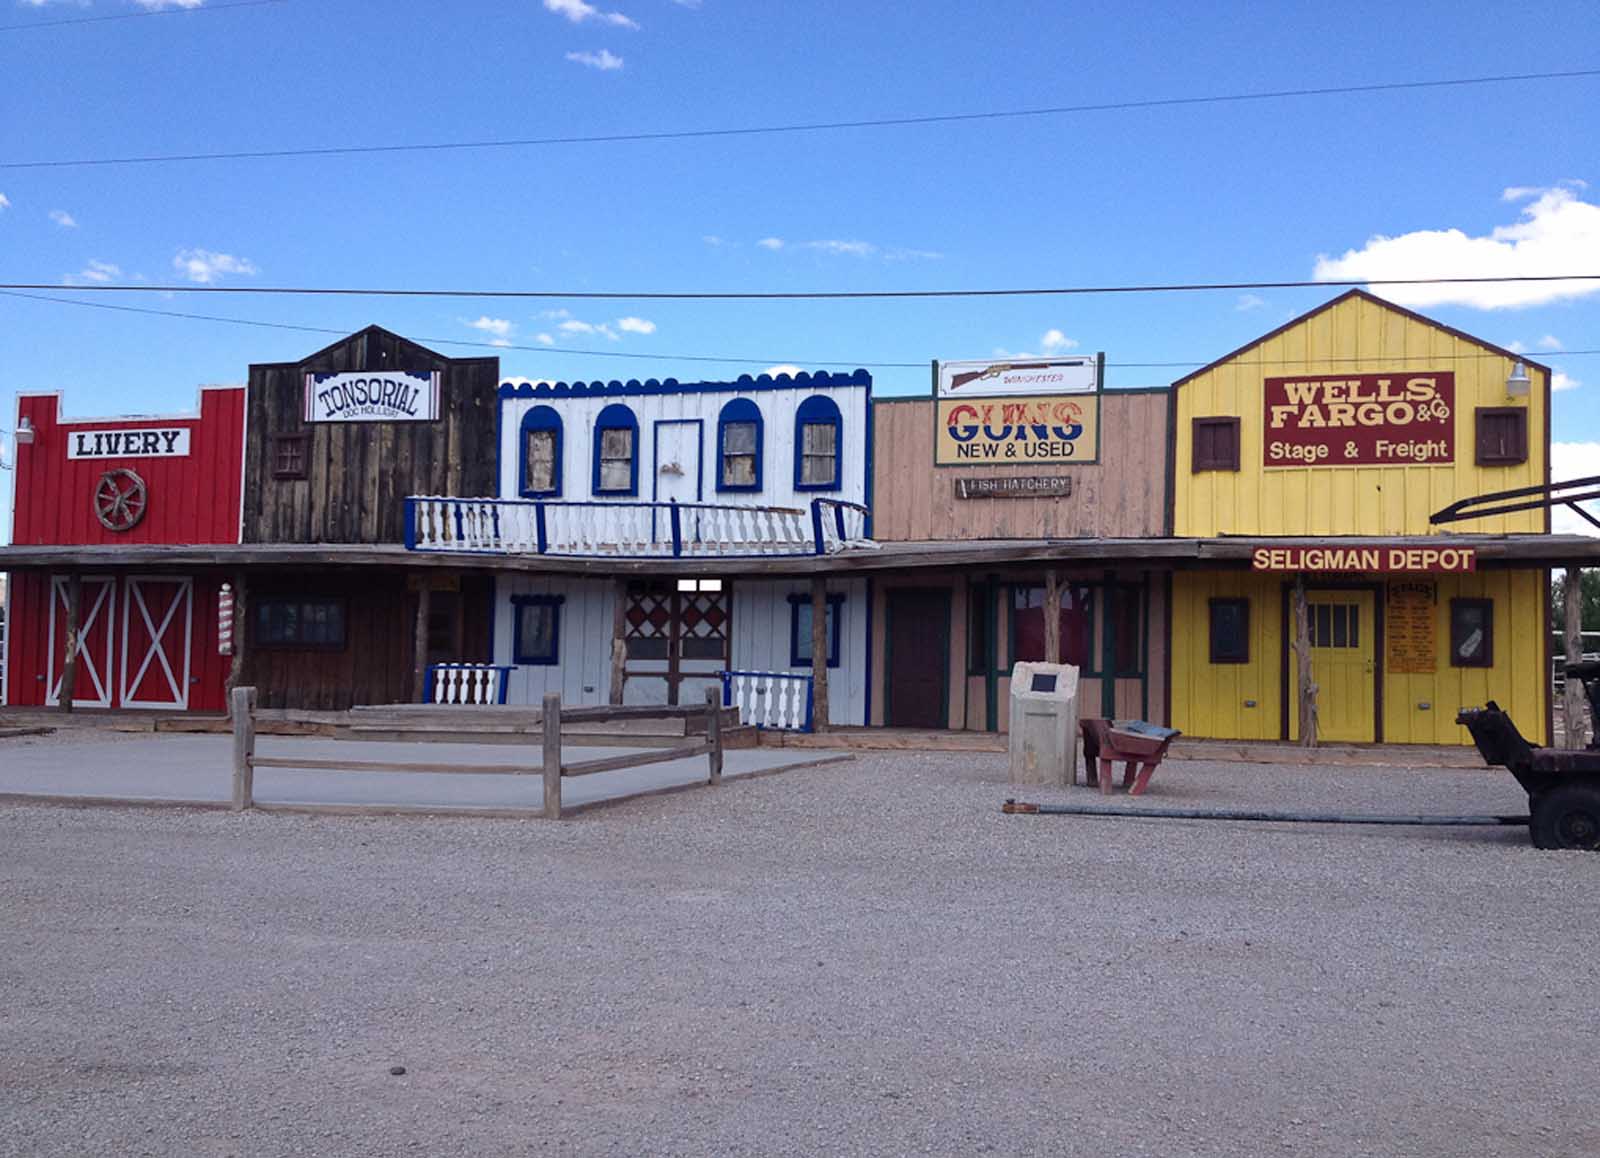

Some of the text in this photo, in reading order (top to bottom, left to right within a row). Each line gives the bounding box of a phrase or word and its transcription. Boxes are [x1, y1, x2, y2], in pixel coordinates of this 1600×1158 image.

[318, 378, 420, 418] TONSORIAL
[1284, 378, 1436, 405] WELLS
[947, 402, 1083, 442] GUNS
[1270, 401, 1415, 428] FARGO
[76, 431, 180, 456] LIVERY
[957, 441, 1075, 458] NEW & USED
[1269, 439, 1448, 463] Stage & Freight
[970, 478, 1067, 490] FISH HATCHERY
[1253, 549, 1474, 570] SELIGMAN DEPOT
